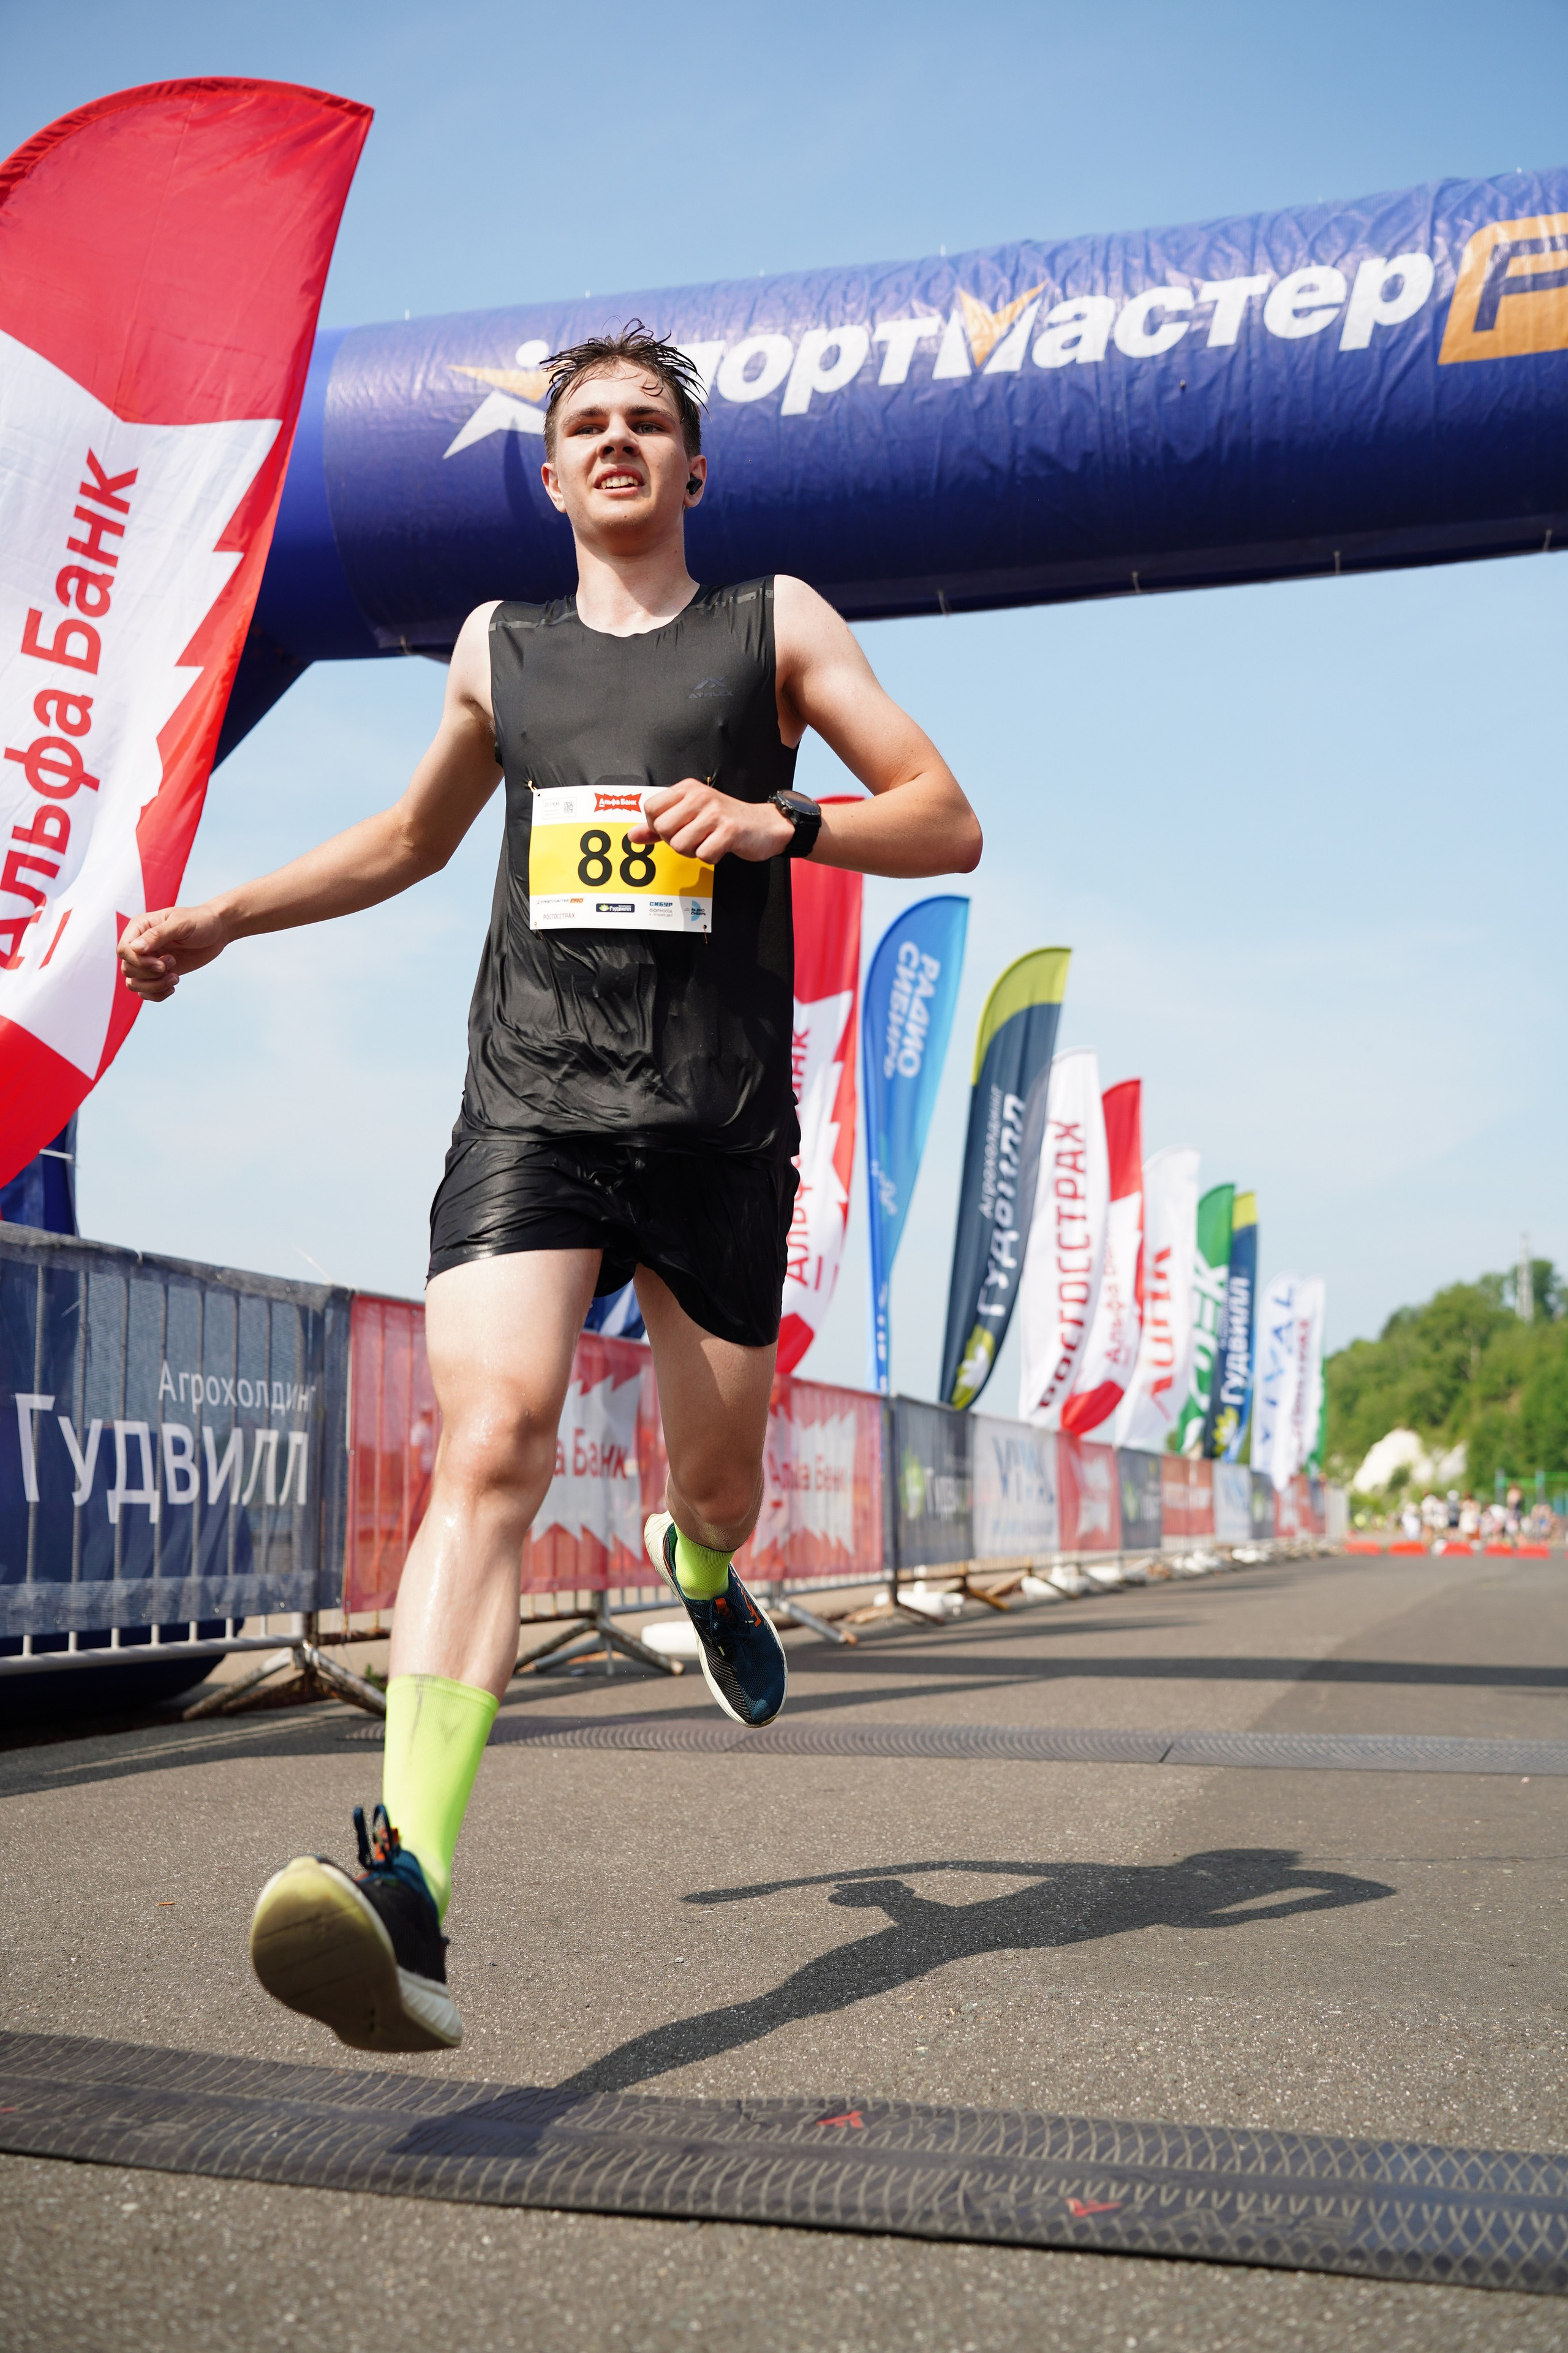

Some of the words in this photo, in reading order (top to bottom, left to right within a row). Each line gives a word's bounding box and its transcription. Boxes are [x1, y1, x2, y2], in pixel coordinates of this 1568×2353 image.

[660, 252, 1434, 415] портМастер
[21, 447, 139, 675] Банк
[578, 829, 656, 887] 88
[599, 798, 620, 807] Альфа
[897, 953, 941, 1078] РАДИО
[1040, 1119, 1091, 1408] РОСГОССТРАХ
[573, 1427, 628, 1479] Банк
